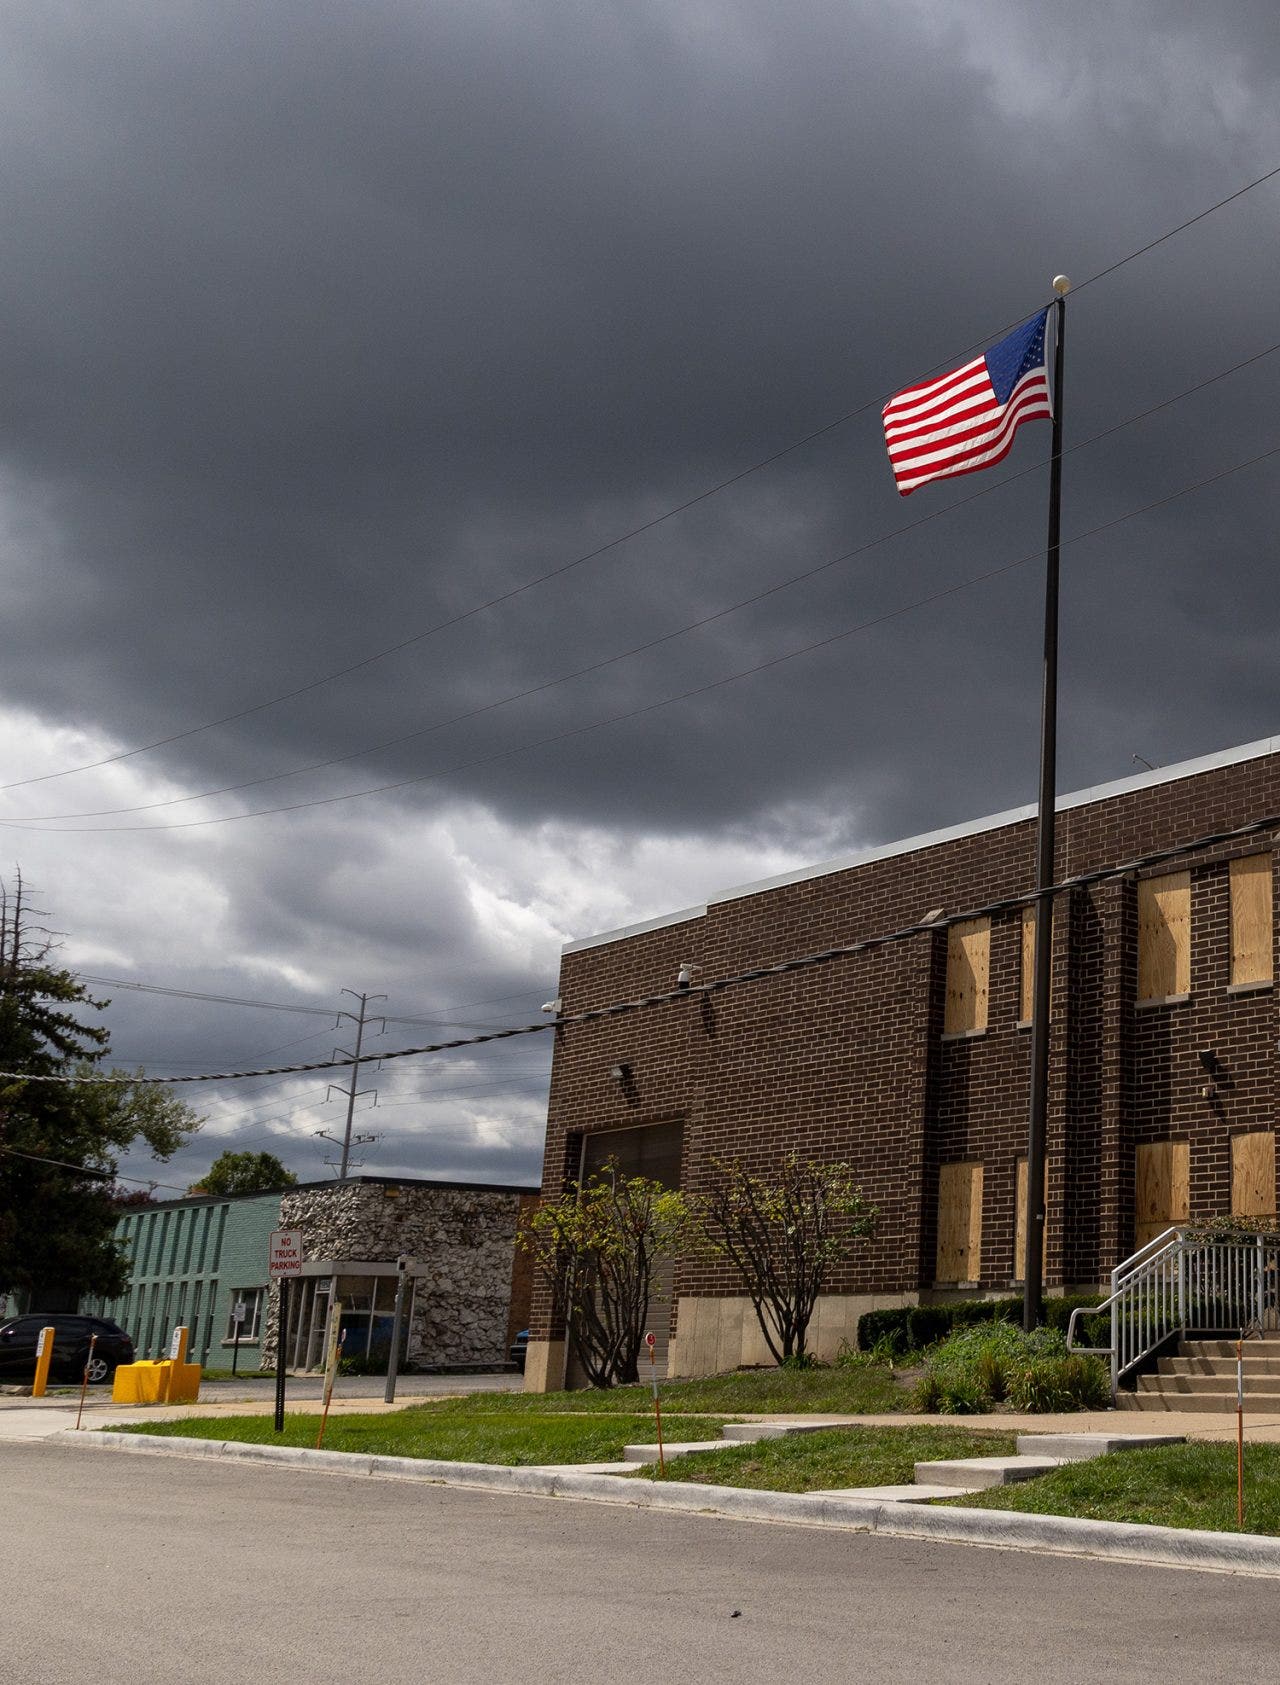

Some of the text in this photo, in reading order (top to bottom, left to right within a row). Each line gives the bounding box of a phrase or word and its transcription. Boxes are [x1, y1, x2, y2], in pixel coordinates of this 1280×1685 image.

[281, 1237, 291, 1246] NO
[274, 1249, 297, 1258] TRUCK
[271, 1260, 300, 1270] PARKING
